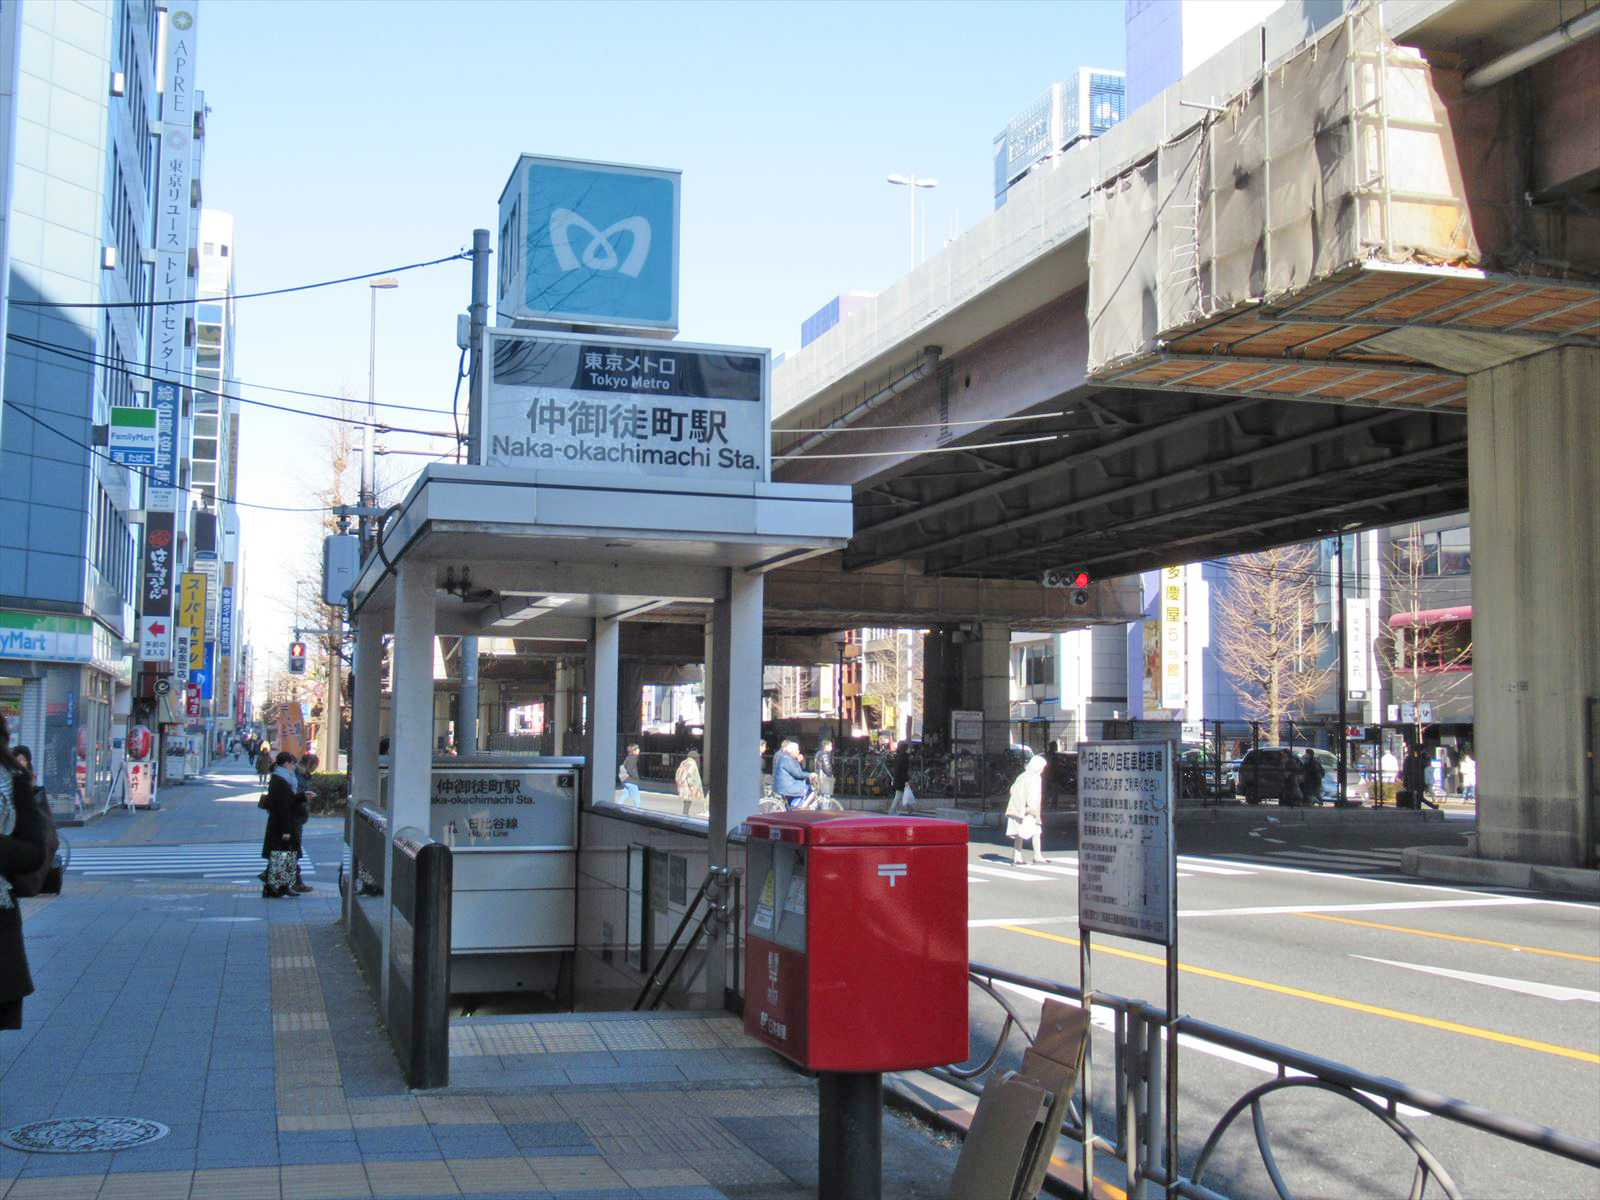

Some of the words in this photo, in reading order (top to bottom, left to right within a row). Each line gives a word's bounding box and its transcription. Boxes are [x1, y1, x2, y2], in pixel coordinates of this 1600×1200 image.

[174, 39, 188, 112] APRE
[166, 158, 183, 246] 東京リユース
[161, 257, 177, 375] トレードセンター
[584, 351, 676, 375] 東京メトロ
[589, 372, 629, 390] Tokyo
[631, 375, 671, 391] Metro
[526, 397, 728, 445] 仲御徒町駅
[111, 432, 155, 443] FamilyMart
[113, 451, 125, 464] 酒
[128, 454, 151, 464] たばこ
[492, 434, 712, 469] Naka-okachimachi
[718, 447, 760, 471] Sta.
[184, 578, 202, 664] スーパーホテル
[1088, 751, 1163, 772] 日利用の自転車駐車場
[437, 778, 521, 794] 仲御徒町駅
[515, 795, 536, 805] Sta.
[468, 817, 518, 830] 日比谷線
[492, 830, 509, 838] Line
